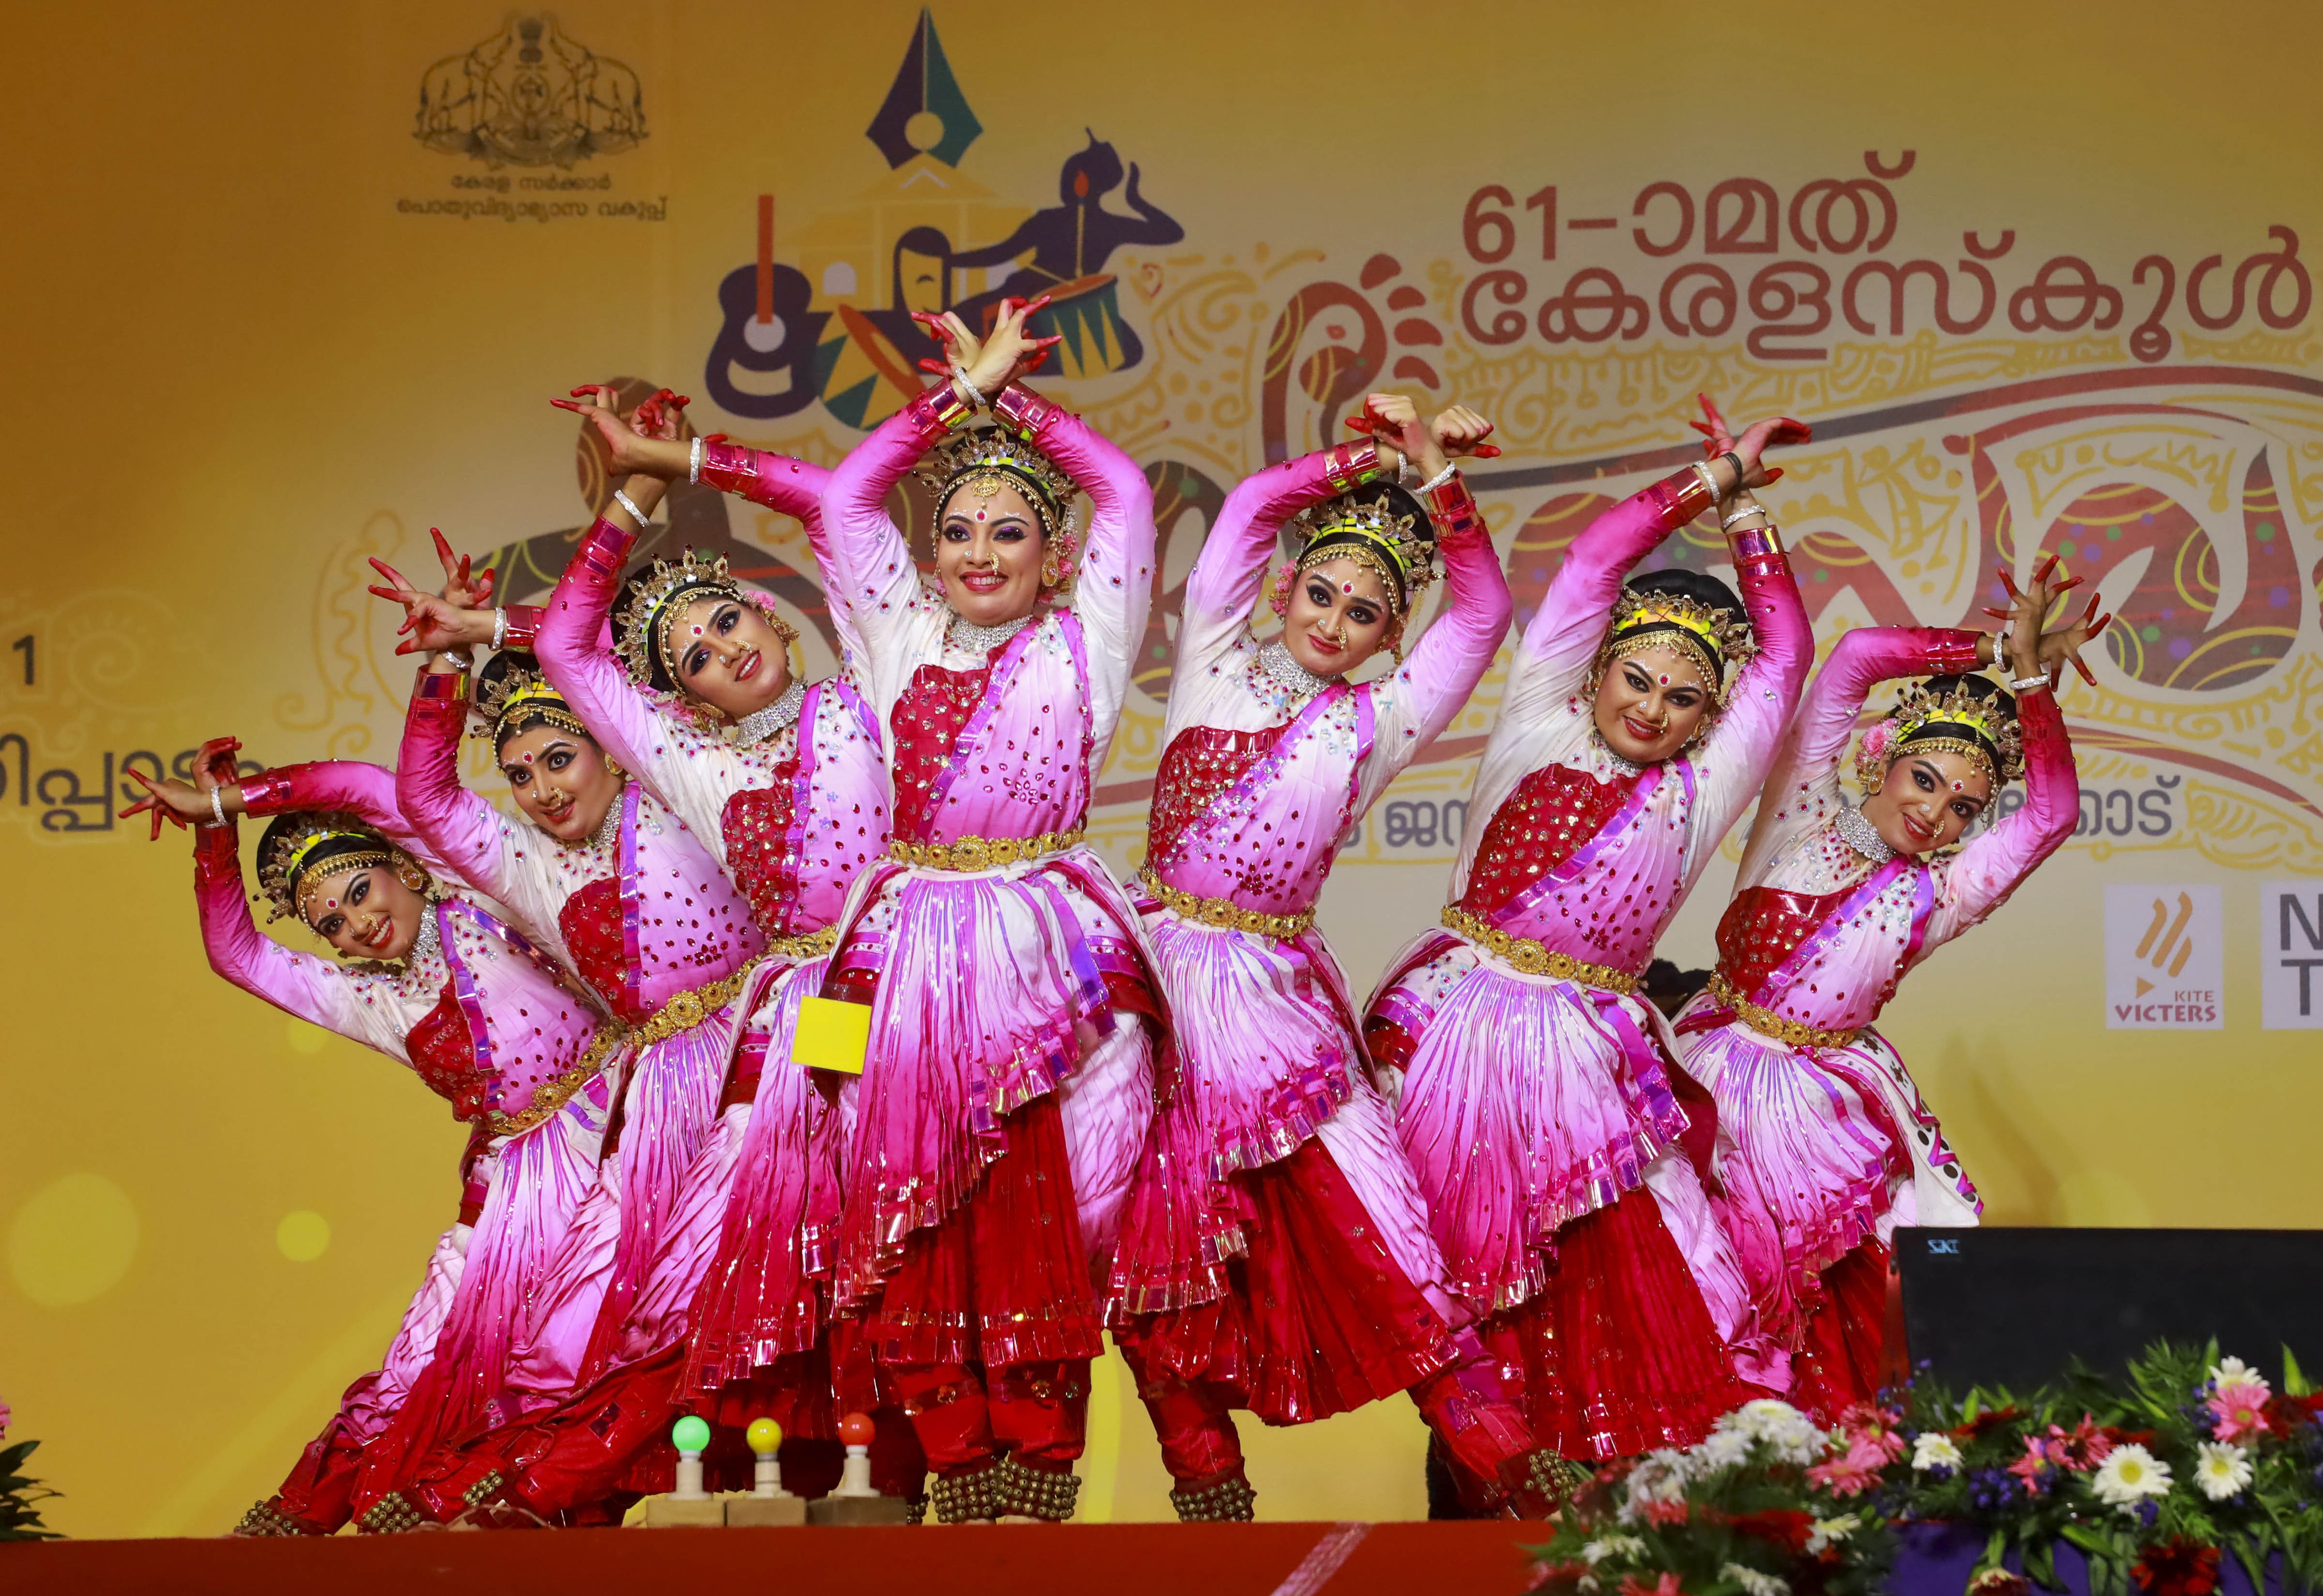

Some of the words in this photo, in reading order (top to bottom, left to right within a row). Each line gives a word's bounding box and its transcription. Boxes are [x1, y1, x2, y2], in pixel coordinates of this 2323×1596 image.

[12, 634, 35, 685] 1
[2174, 990, 2215, 1002] KITE
[2114, 1004, 2217, 1023] VICTERS
